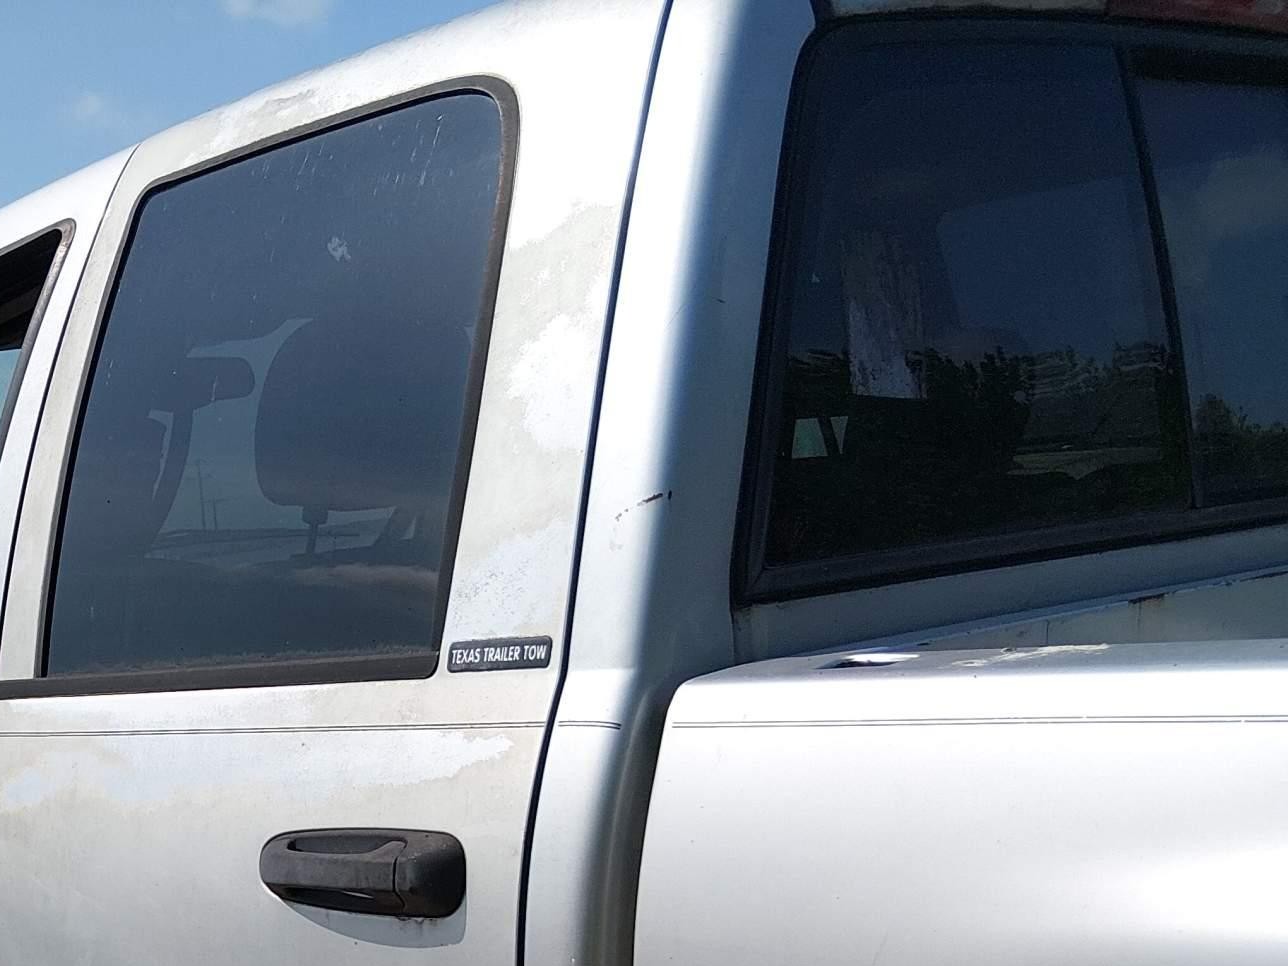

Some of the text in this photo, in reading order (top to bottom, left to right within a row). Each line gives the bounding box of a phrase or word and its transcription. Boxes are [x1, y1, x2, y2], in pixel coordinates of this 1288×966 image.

[452, 644, 547, 664] TEXAS TRAILER TOW
